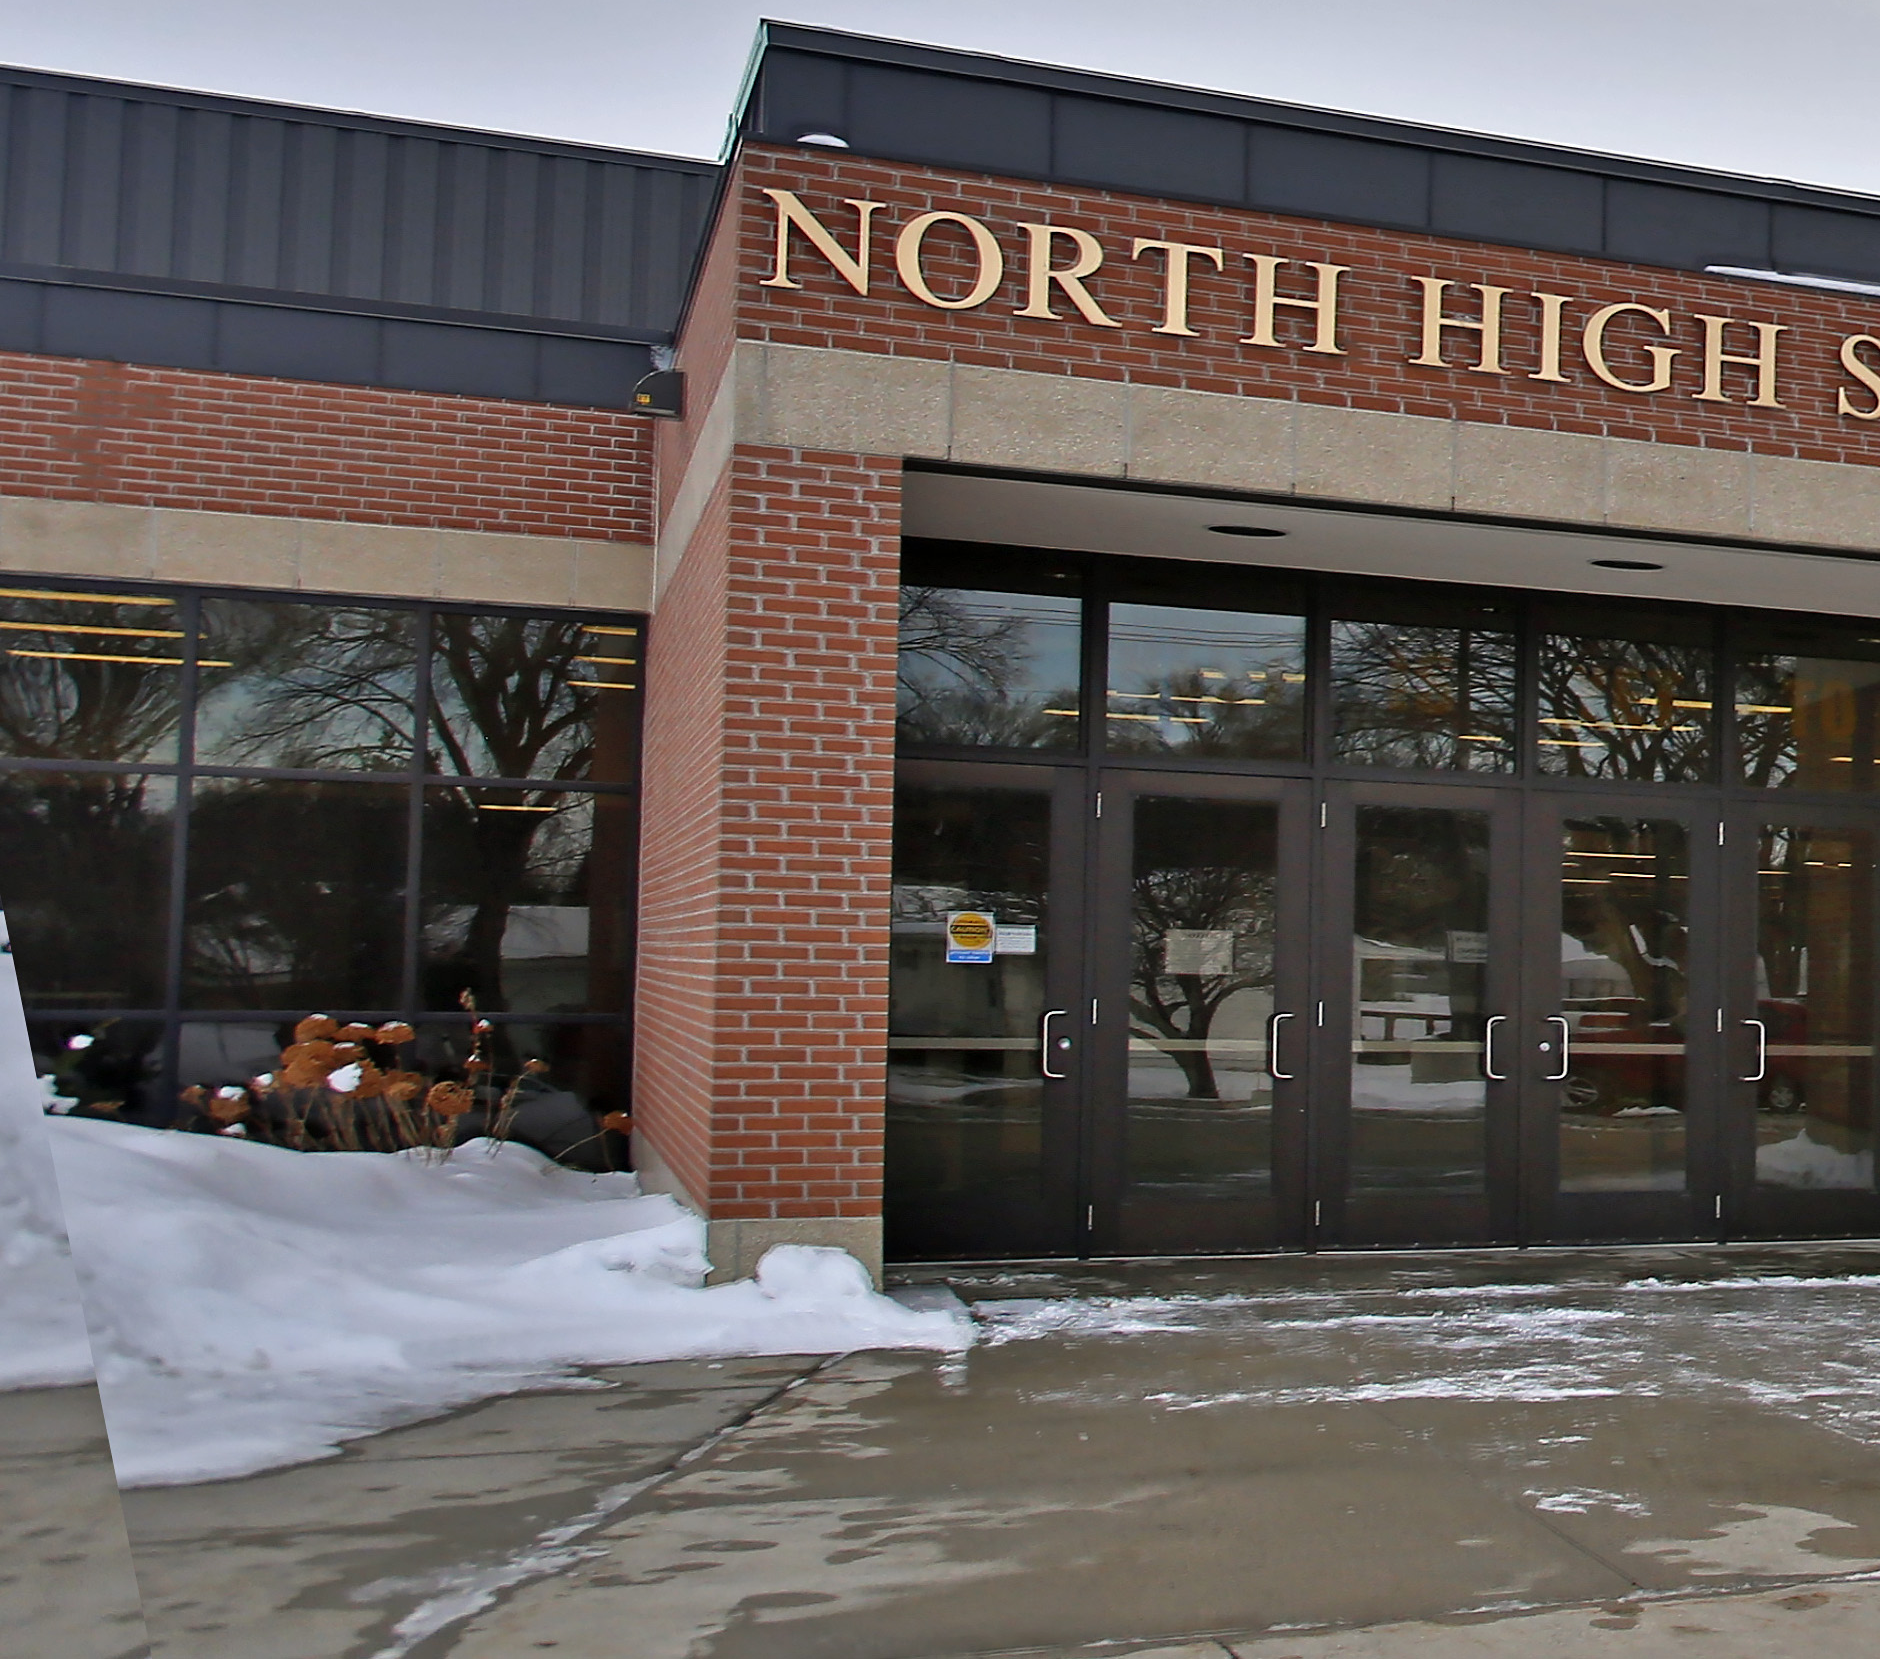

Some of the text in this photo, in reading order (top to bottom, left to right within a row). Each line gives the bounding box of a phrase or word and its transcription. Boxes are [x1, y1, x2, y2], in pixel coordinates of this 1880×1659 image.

[759, 188, 1351, 355] NORTH
[1408, 275, 1789, 409] HIGH
[1783, 679, 1856, 741] TO
